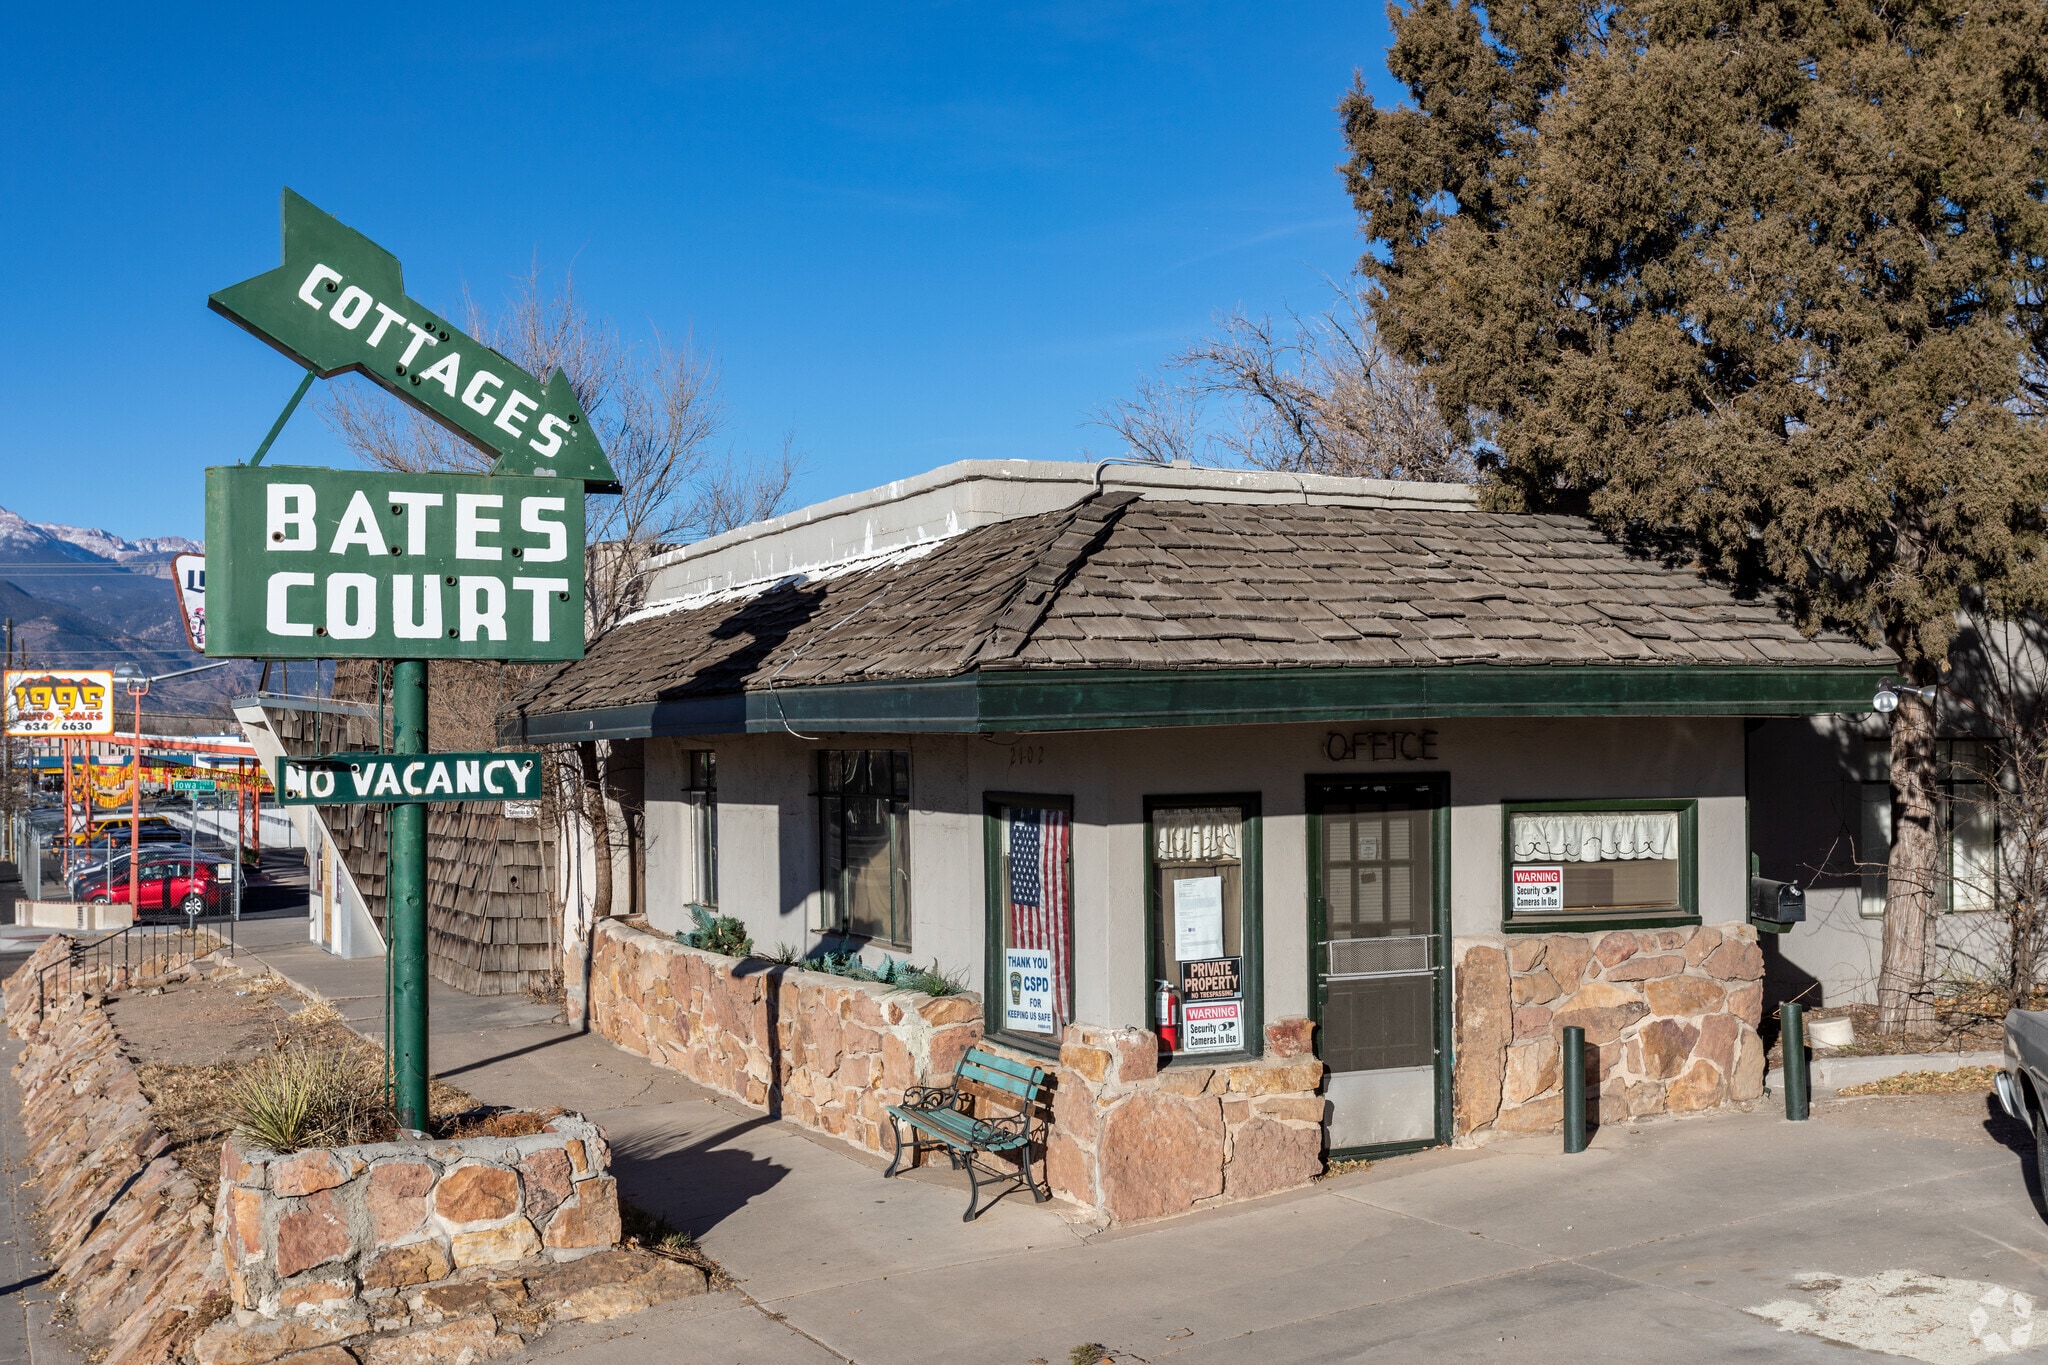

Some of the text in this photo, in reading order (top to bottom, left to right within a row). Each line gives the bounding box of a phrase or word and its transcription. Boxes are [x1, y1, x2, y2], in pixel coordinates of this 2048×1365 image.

[299, 263, 572, 457] COTTAGES
[266, 483, 568, 562] BATES
[266, 571, 569, 642] COURT
[13, 686, 105, 712] 1995
[18, 711, 103, 721] AUTO SALES
[25, 722, 92, 731] 634 6630
[1328, 729, 1439, 761] OFFICE
[175, 781, 197, 789] Iowa
[285, 760, 532, 798] NO VACANCY
[1516, 872, 1558, 882] WARNING
[1517, 886, 1540, 896] Security
[1517, 897, 1558, 906] Cameras In Use
[1008, 956, 1048, 969] THANK YOU
[1190, 961, 1232, 978] PRIVATE
[1024, 976, 1049, 992] CSPD
[1184, 975, 1239, 992] PROPERTY
[1200, 990, 1233, 998] TRESPASSING
[1030, 998, 1041, 1008] FOR
[1008, 1010, 1051, 1022] KEEPING US SAFE
[1188, 1006, 1235, 1019] WARNING
[1190, 1023, 1216, 1034] Security
[1190, 1033, 1236, 1046] Cameras In Use
